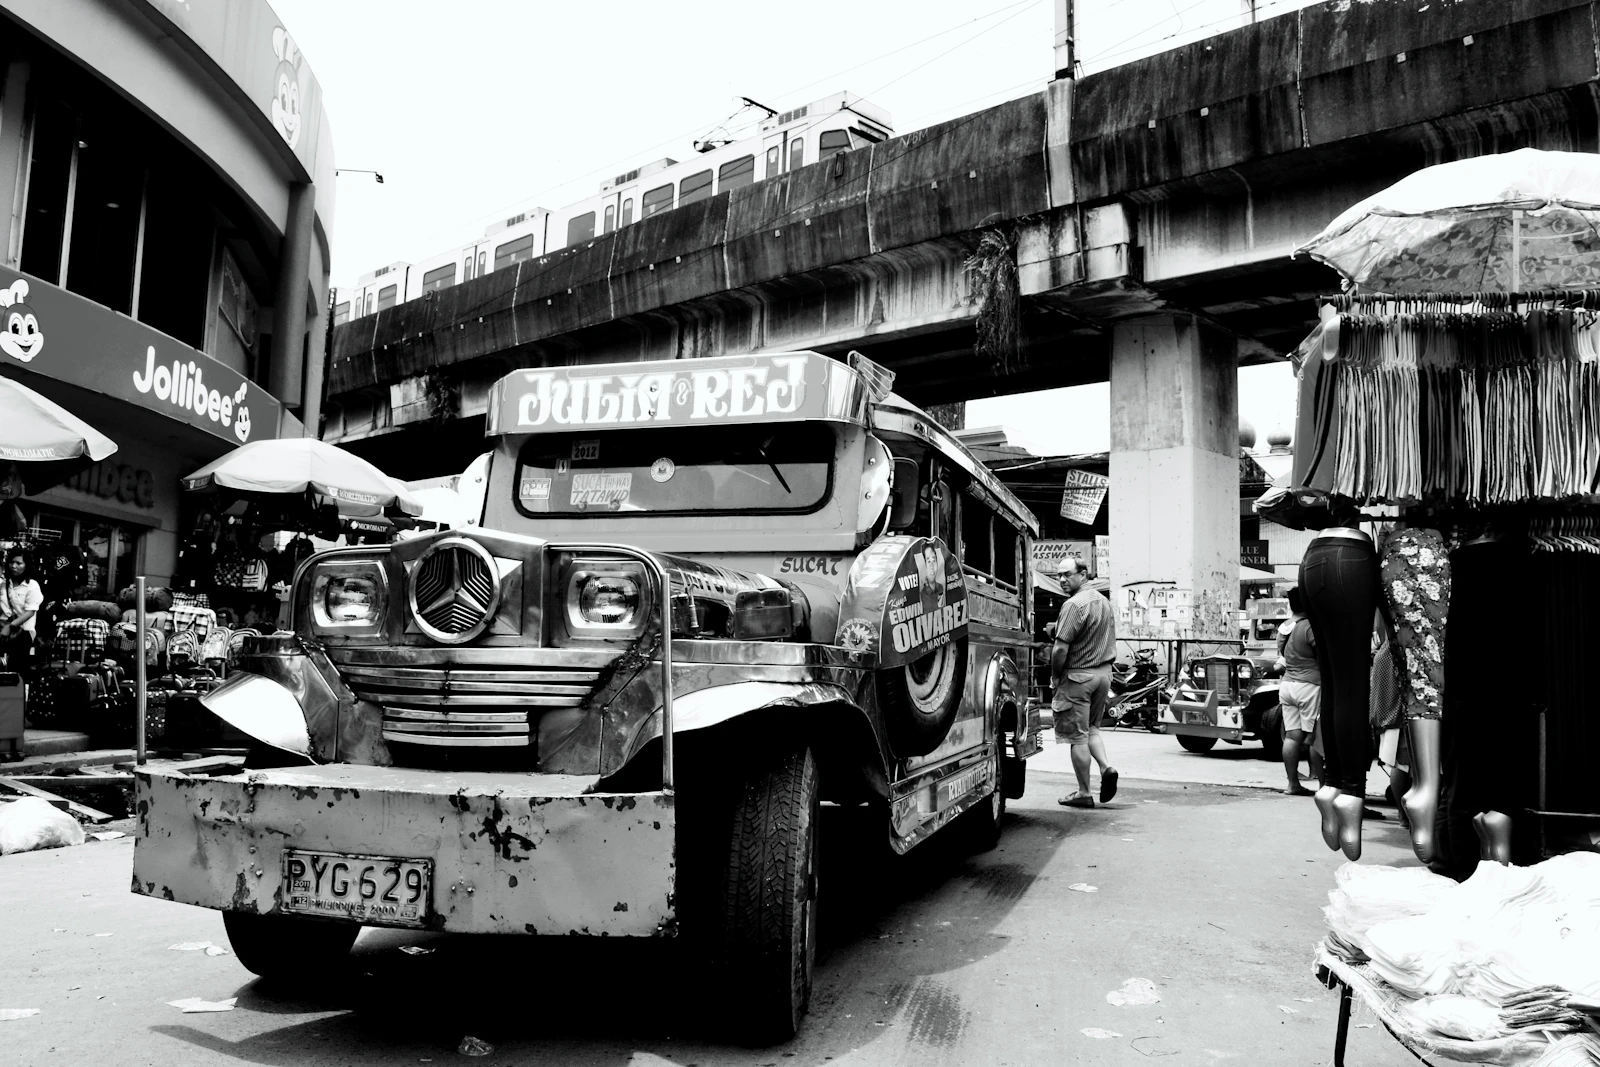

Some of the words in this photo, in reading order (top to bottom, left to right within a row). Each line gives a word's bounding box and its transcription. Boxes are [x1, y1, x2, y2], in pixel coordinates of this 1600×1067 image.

[133, 345, 233, 427] Jollibee
[517, 373, 675, 426] JULIA
[675, 380, 689, 406] &
[690, 356, 808, 419] REJ
[1, 446, 56, 458] WORLDMATIC
[574, 446, 597, 459] 2012
[573, 474, 611, 490] SUCAT
[1069, 469, 1107, 489] STALLS
[339, 489, 377, 504] WORLDMATIC
[572, 489, 630, 503] TATAWID
[1032, 544, 1072, 552] JINNY
[779, 556, 843, 577] SUCAT
[898, 573, 918, 591] VOTE!
[888, 601, 923, 625] EDWIN
[892, 598, 969, 653] OLIVAREZ
[926, 633, 951, 651] MAYOR
[948, 776, 967, 801] RYAN
[359, 864, 423, 904] 629
